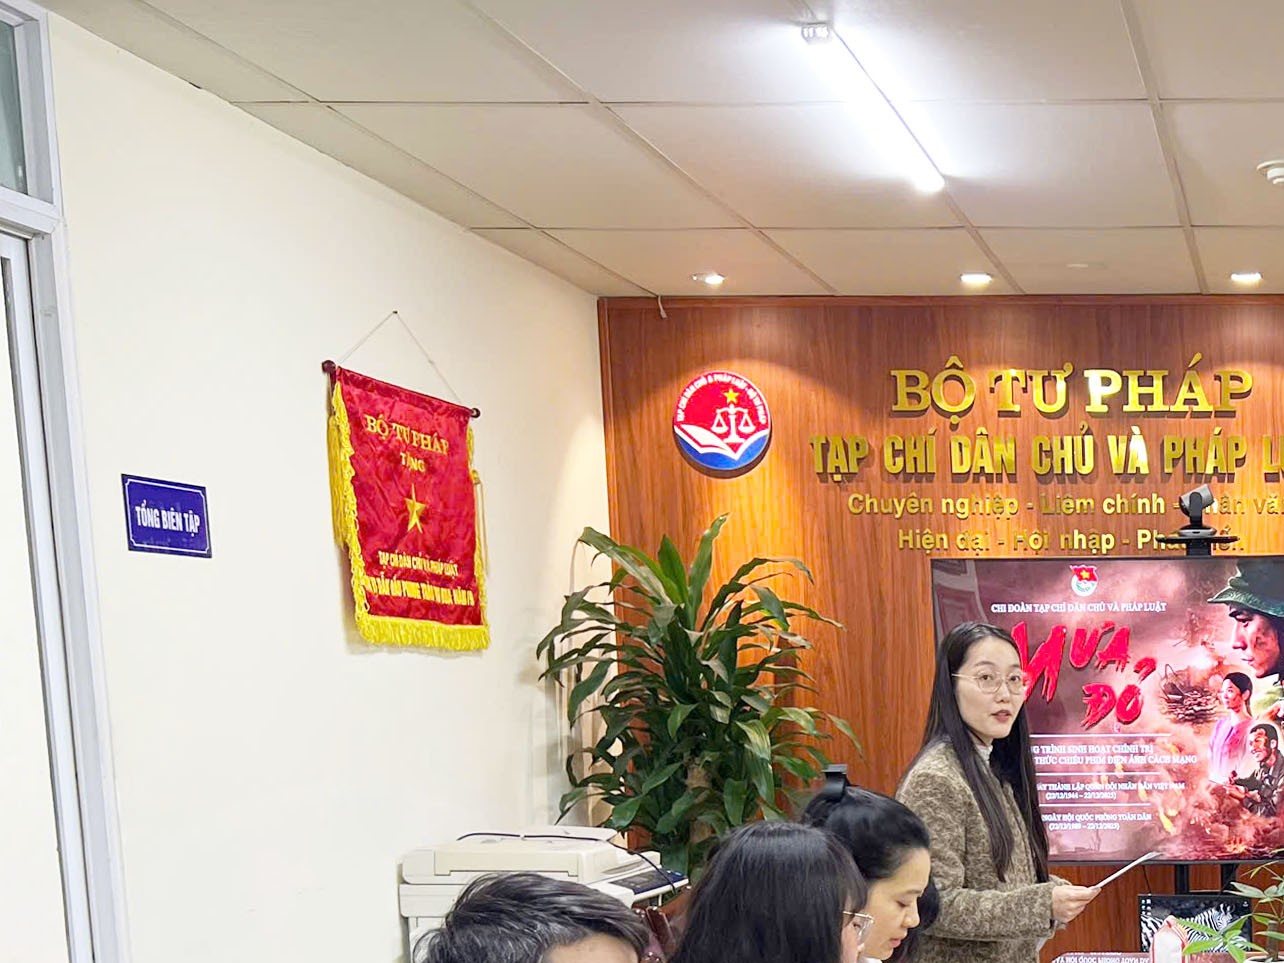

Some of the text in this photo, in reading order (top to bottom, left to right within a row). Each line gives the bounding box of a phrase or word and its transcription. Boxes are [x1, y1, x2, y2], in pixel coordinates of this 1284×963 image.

[889, 352, 1253, 425] BỘ TƯ PHÁP
[363, 413, 389, 440] BỘ
[411, 432, 450, 456] PHÁP
[809, 435, 869, 482] TẠP
[883, 427, 938, 475] CHÍ
[950, 426, 1017, 475] DÂN
[1031, 420, 1094, 476] CHỦ
[1107, 425, 1150, 475] VÀ
[1163, 426, 1248, 475] PHÁP
[134, 498, 201, 537] TỔNG BIÊN TẬP
[847, 492, 934, 519] Chuyên
[940, 492, 1020, 520] nghiệp
[1040, 493, 1096, 516] Liêm
[1102, 493, 1166, 516] chính
[1204, 494, 1246, 516] hân
[897, 529, 950, 555] Hiện
[955, 529, 990, 556] đại
[1013, 529, 1049, 556] Hội
[1059, 529, 1116, 555] nhập
[990, 600, 1167, 614] CHI ĐOÀN TẠP CHÍ DÂN CHỦ VÀ PHÁP LUẬT
[1081, 656, 1158, 730] ĐỎ
